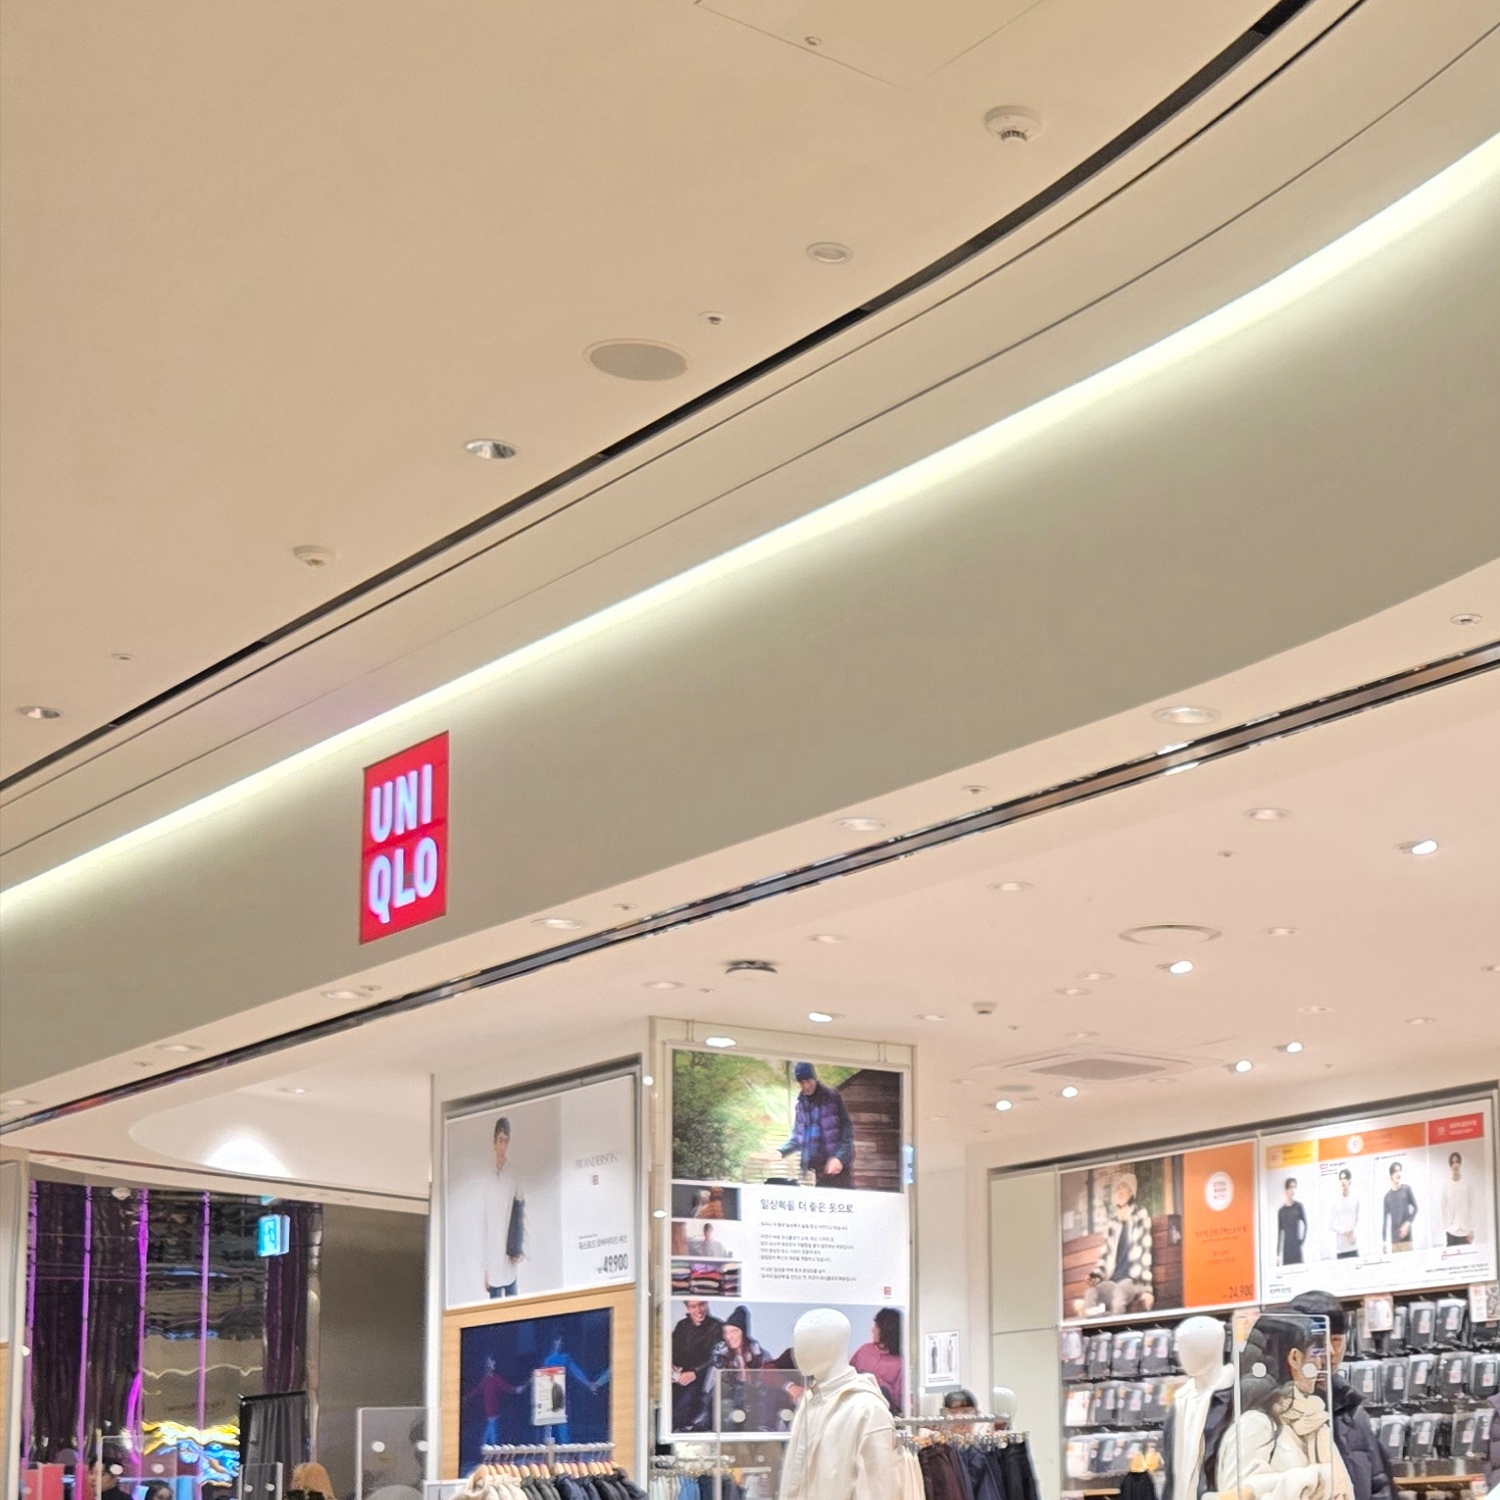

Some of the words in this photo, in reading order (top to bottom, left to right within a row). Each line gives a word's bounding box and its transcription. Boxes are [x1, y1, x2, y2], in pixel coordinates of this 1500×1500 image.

[371, 763, 433, 843] UNI
[368, 836, 438, 924] QLO
[760, 1199, 795, 1212] 일상복을
[798, 1201, 807, 1212] 더
[809, 1202, 826, 1213] 좋은
[829, 1203, 854, 1214] 옷으로
[603, 1253, 629, 1273] 49,900
